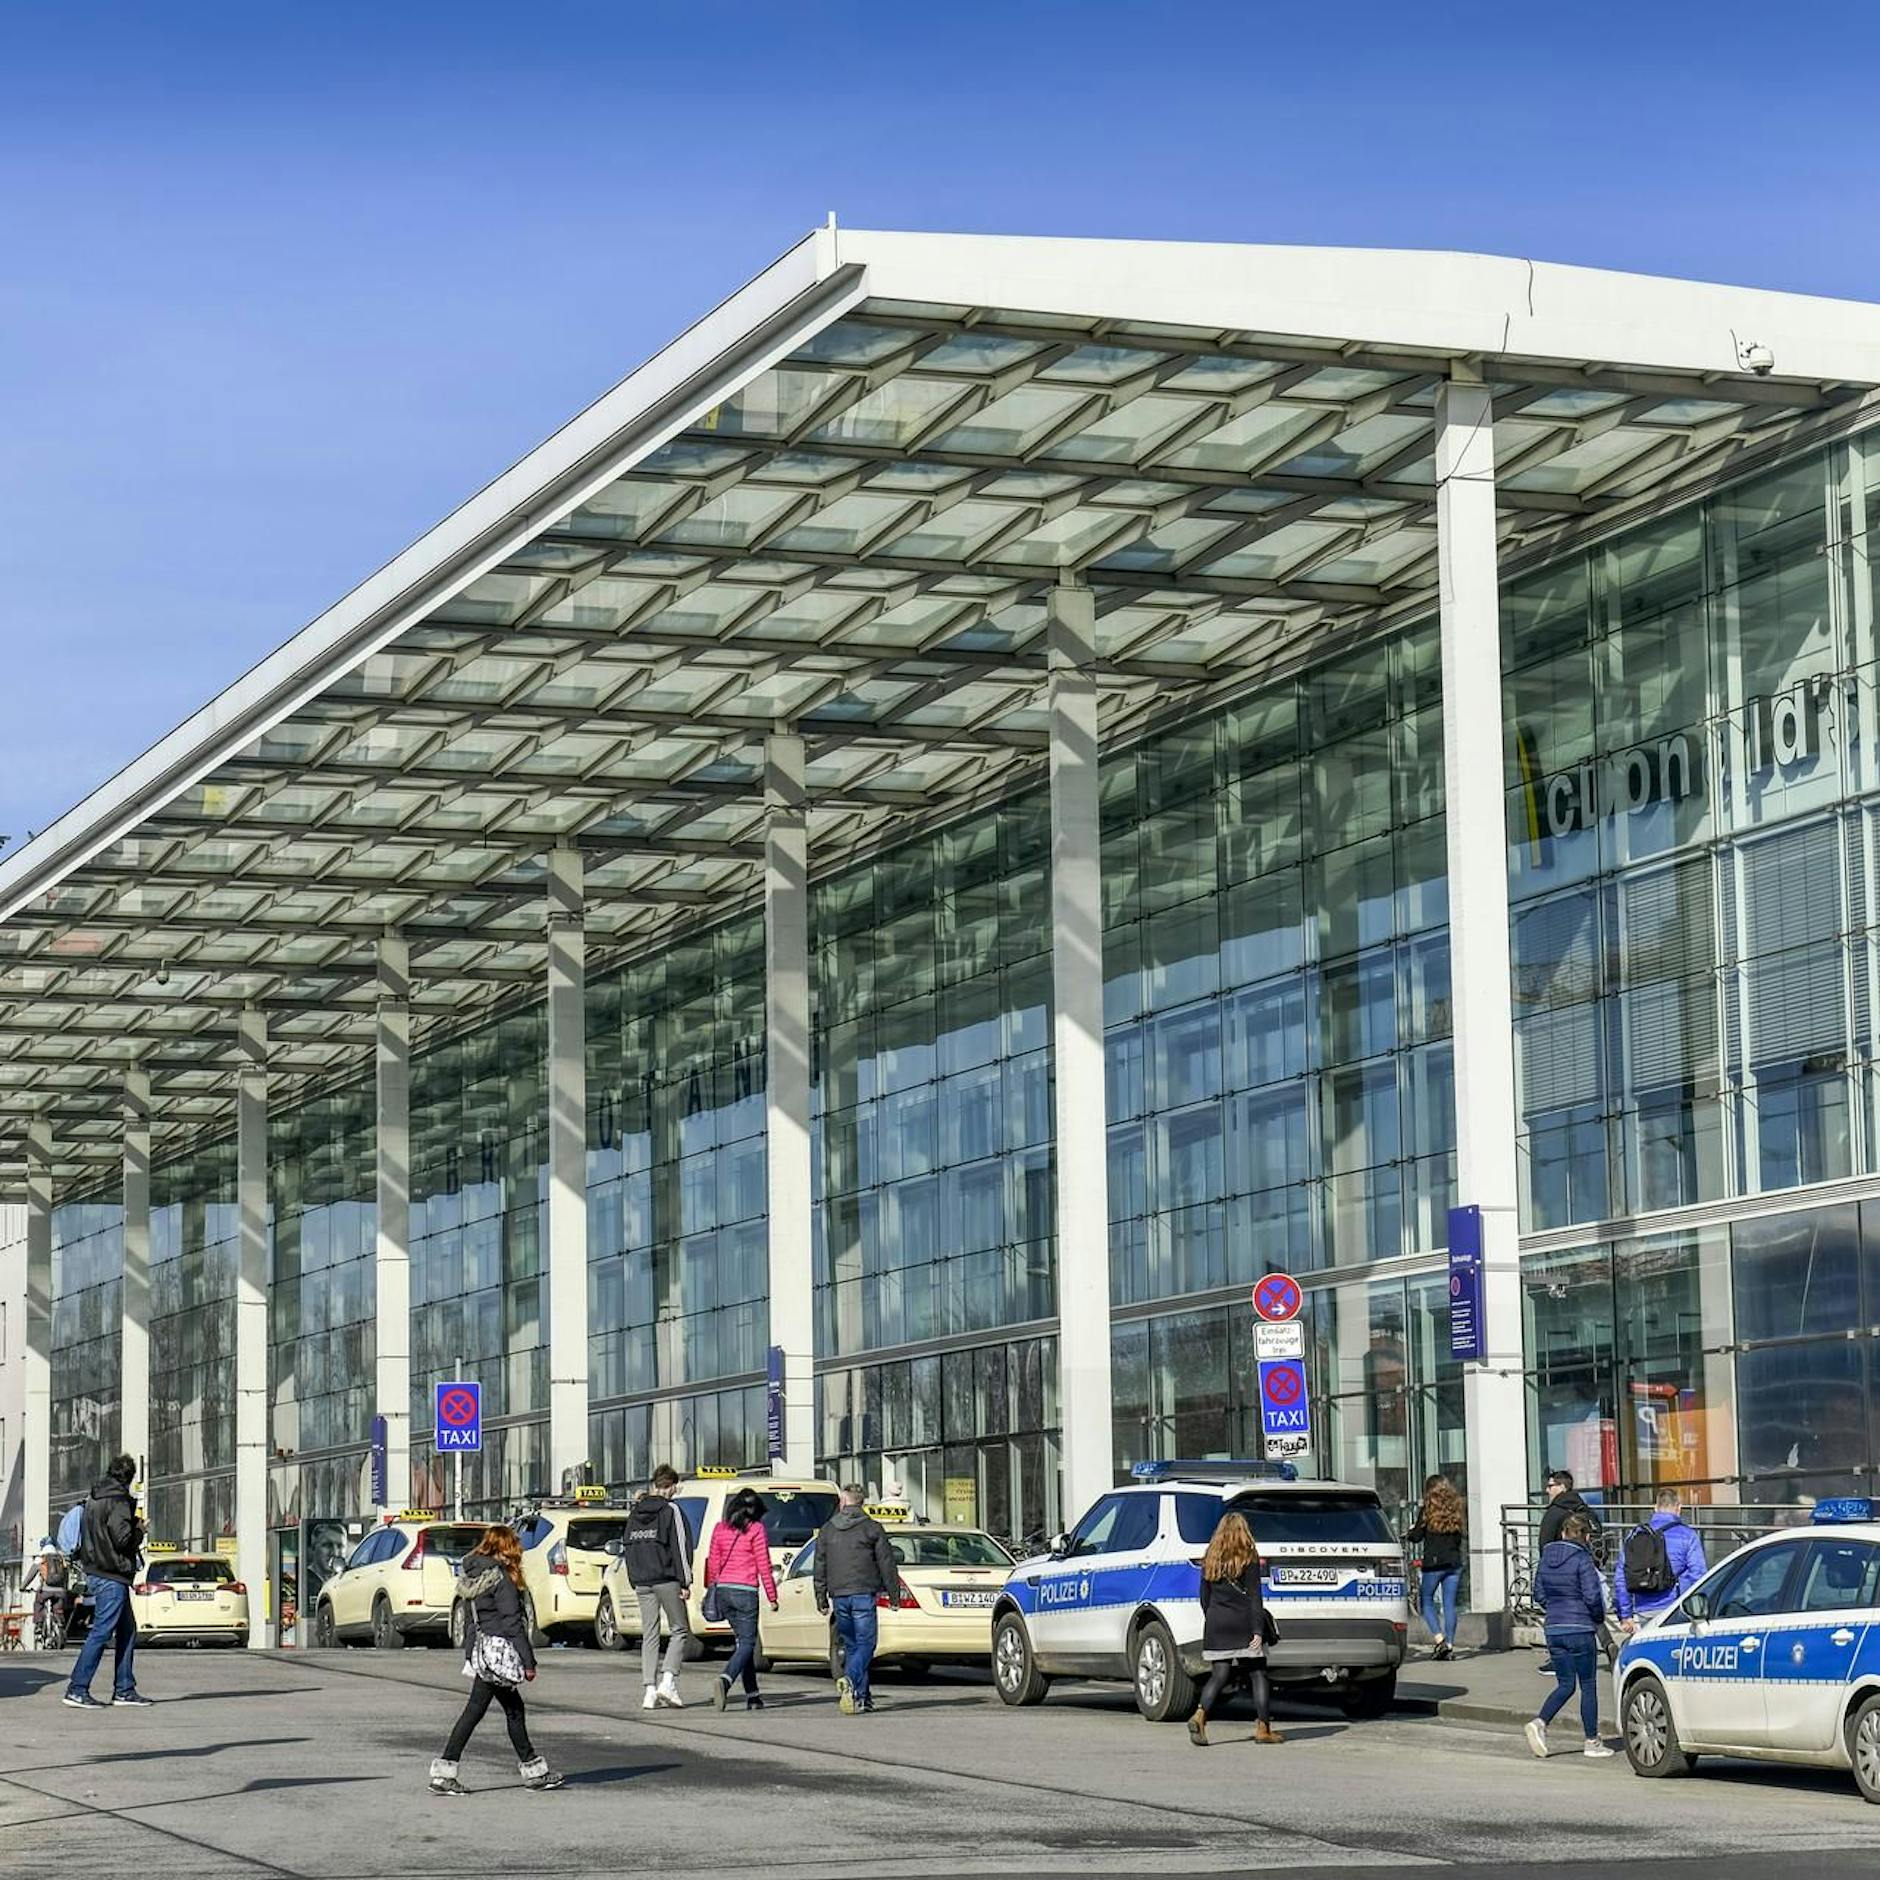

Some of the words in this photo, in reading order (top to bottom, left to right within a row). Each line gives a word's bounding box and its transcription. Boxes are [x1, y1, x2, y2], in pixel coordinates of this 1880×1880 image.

[1267, 1409, 1305, 1428] TAXI
[440, 1429, 476, 1445] TAXI
[582, 1489, 604, 1498] TAXI
[1040, 1581, 1078, 1605] POLIZEI
[1356, 1583, 1401, 1597] POLIZEI
[1683, 1645, 1739, 1670] POLIZEI
